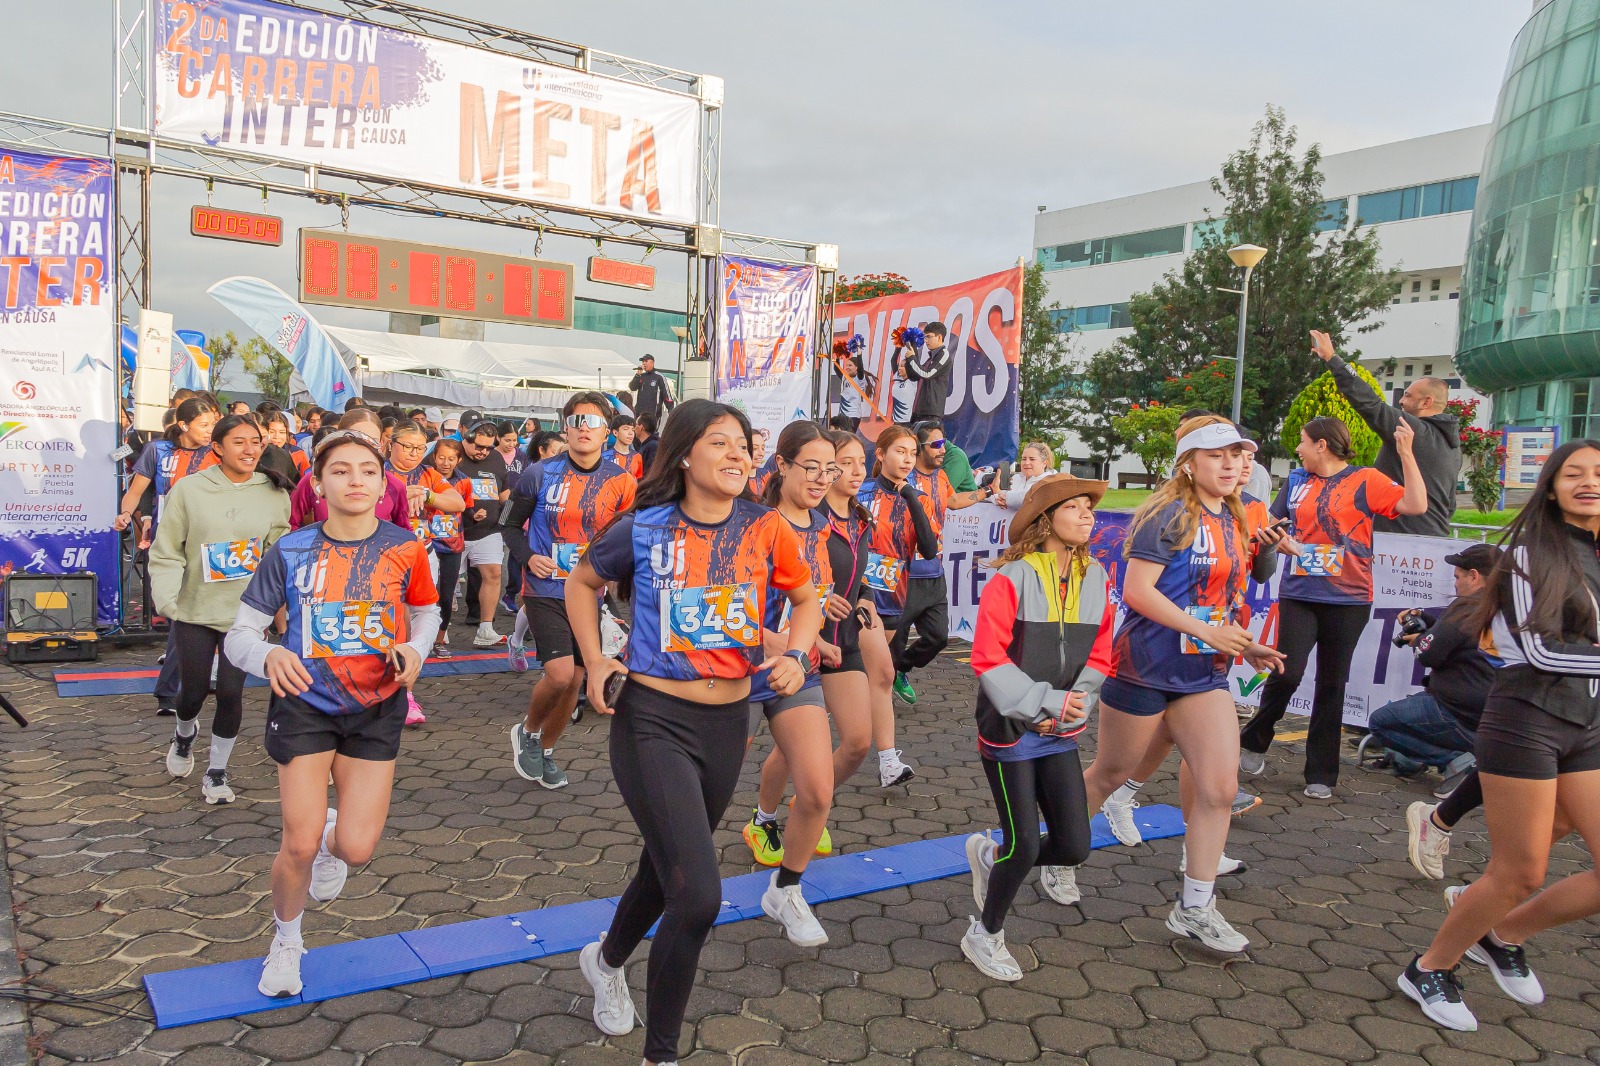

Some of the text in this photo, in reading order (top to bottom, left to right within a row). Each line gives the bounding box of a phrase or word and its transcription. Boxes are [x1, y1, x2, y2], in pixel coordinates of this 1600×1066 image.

[235, 13, 379, 64] EDICIÓN
[177, 48, 381, 110] CARRERA
[220, 94, 358, 150] INTER
[362, 107, 391, 124] CON
[360, 126, 406, 145] CAUSA
[459, 81, 661, 215] META
[0, 187, 105, 219] EDICIÓN
[0, 220, 104, 256] RERA
[15, 311, 56, 323] CAUSA
[719, 311, 808, 341] CARRERA
[162, 455, 179, 472] Ui
[41, 486, 74, 496] Ánimas
[475, 484, 494, 494] 301
[545, 482, 571, 505] Ui
[5, 503, 82, 512] Universidad
[432, 520, 453, 532] 419
[1191, 524, 1216, 554] Ui
[61, 547, 91, 568] 5K
[216, 549, 253, 569] 162
[650, 539, 685, 576] Ui
[1190, 554, 1217, 565] Inter
[1301, 552, 1337, 568] 237
[294, 558, 328, 593] Ui
[864, 562, 896, 580] 203
[1400, 570, 1434, 578] MARRIOTT
[1381, 585, 1433, 601] Las Ánimas
[1402, 577, 1433, 589] Puebla
[679, 602, 747, 633] 345
[320, 615, 383, 641] 355
